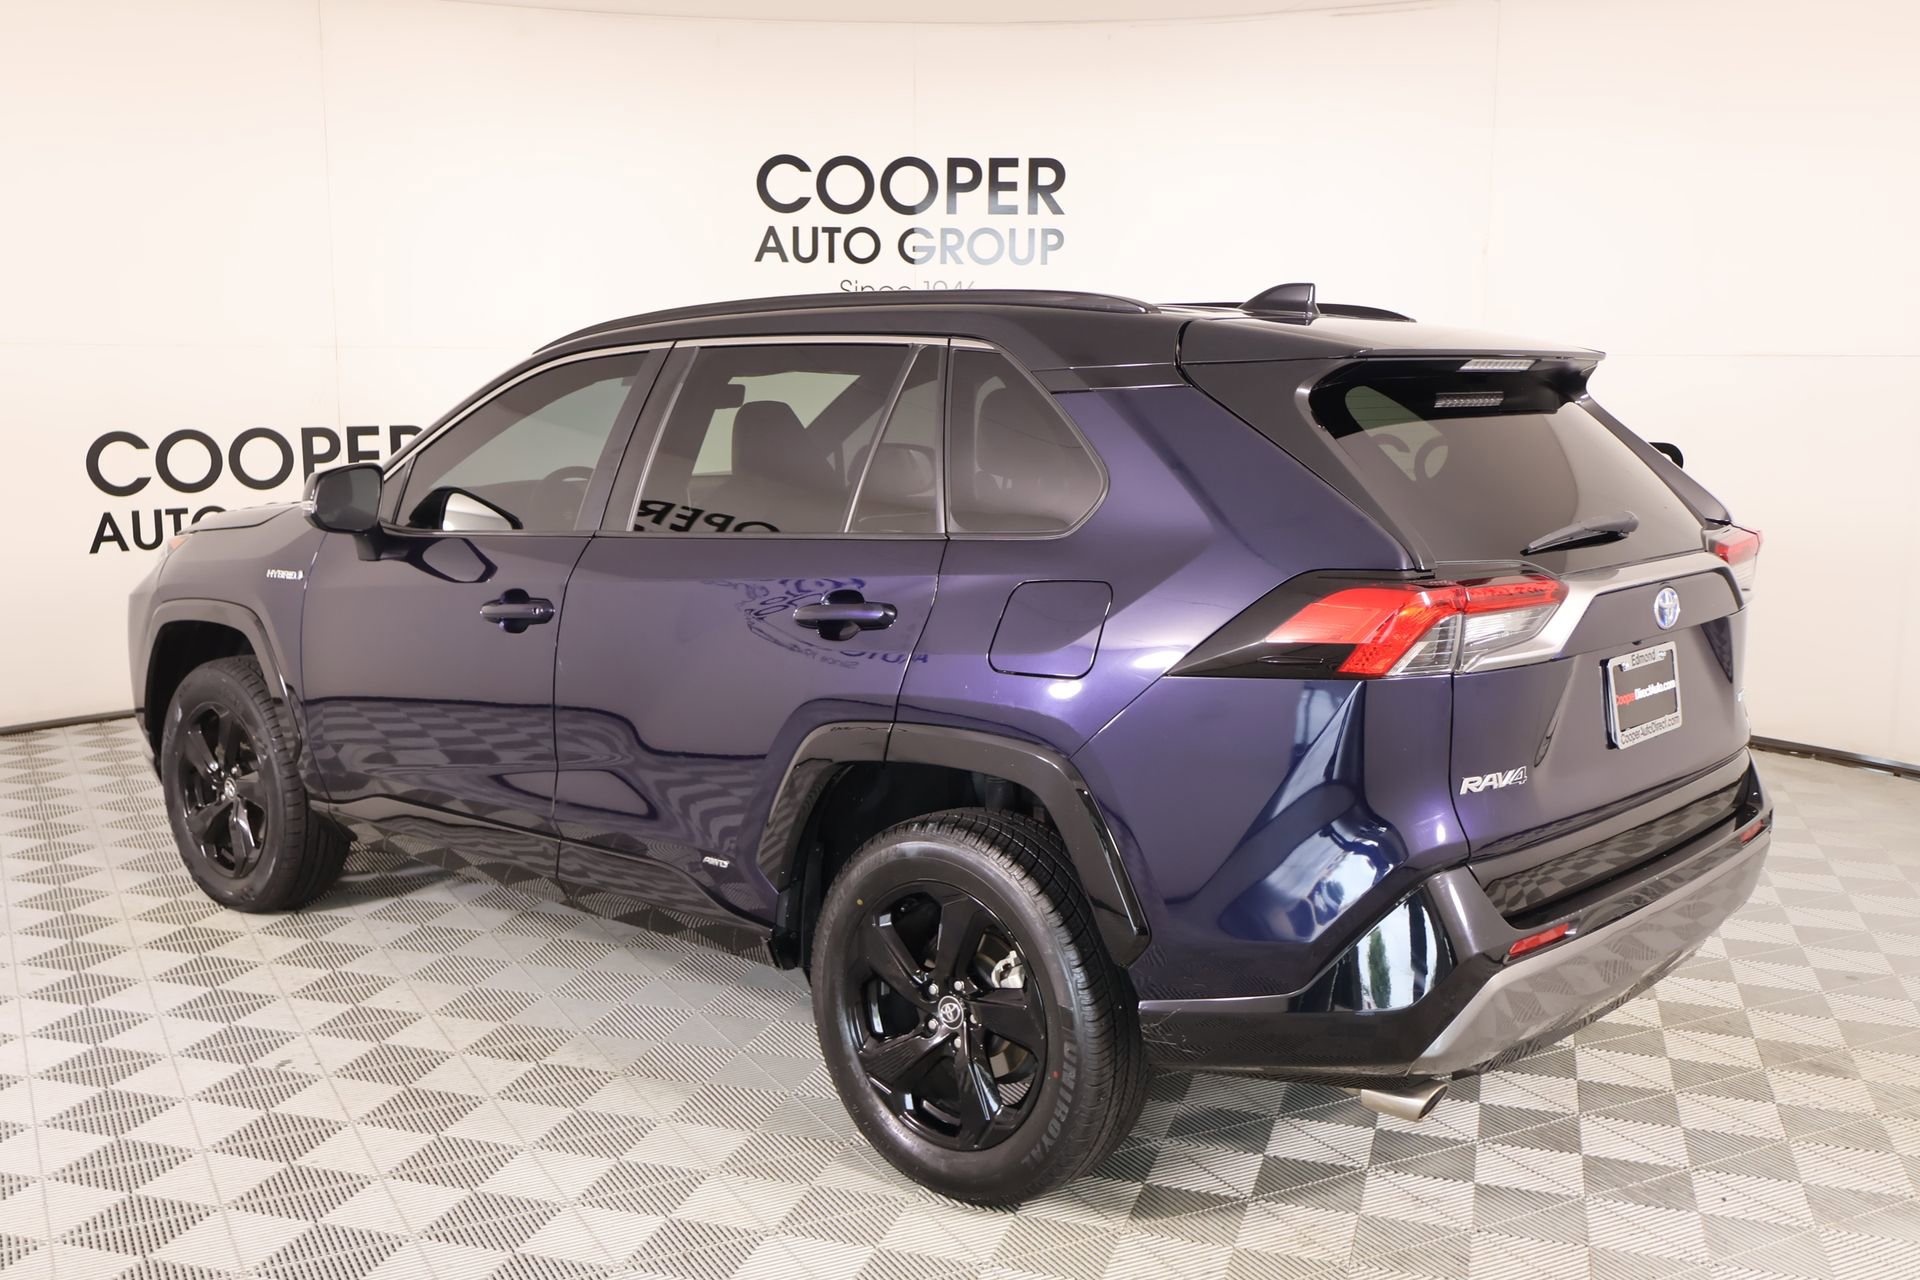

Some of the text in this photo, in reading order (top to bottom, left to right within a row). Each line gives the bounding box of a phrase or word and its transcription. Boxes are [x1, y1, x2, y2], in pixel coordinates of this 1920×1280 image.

[756, 154, 1066, 216] COOPER
[754, 225, 1065, 266] AUTO GROUP
[89, 505, 228, 554] AUT
[266, 568, 297, 580] HYBRID
[1630, 648, 1657, 667] Edmond
[1620, 715, 1681, 745] CooperAutoDirect.com
[1459, 765, 1528, 796] RAV4
[1020, 1040, 1078, 1169] UNIROYAL
